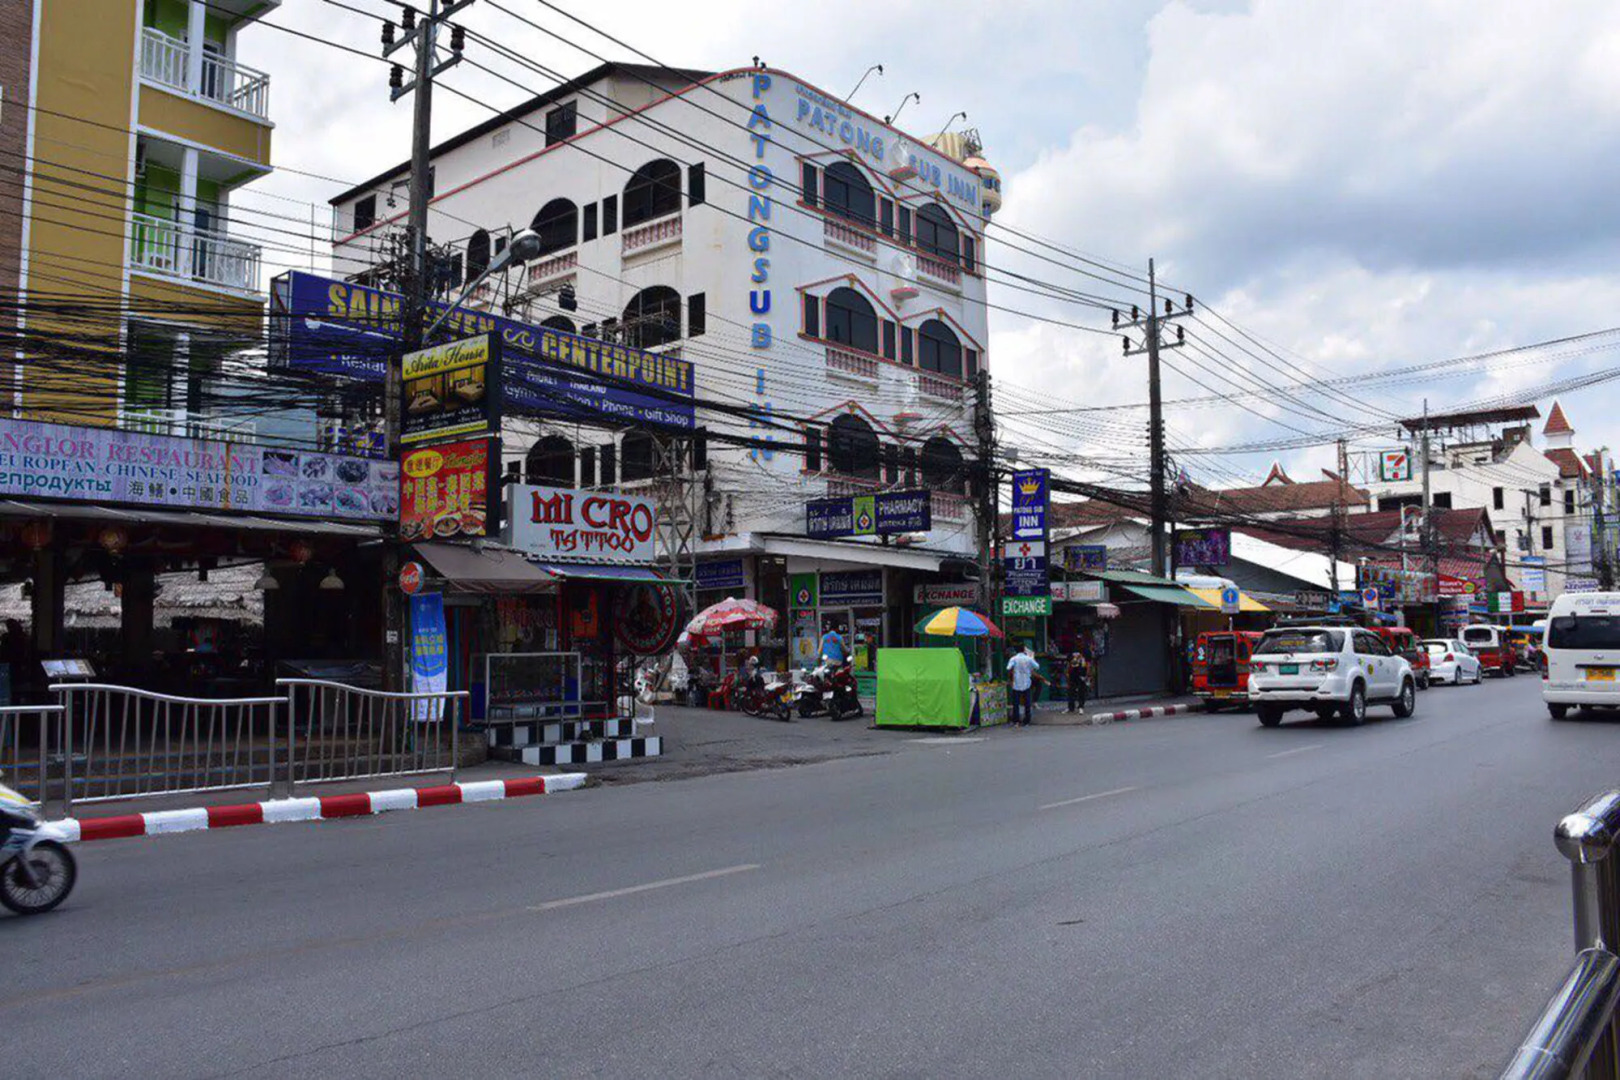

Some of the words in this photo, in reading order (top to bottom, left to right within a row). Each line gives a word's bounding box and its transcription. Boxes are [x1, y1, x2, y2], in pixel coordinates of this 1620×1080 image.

[796, 97, 885, 160] PATONG
[907, 153, 942, 187] SUB
[947, 173, 977, 206] INN
[443, 342, 486, 366] House
[540, 331, 690, 390] CENTERPOINT
[0, 432, 95, 459] NGLOR
[106, 442, 260, 475] RESTAURANT
[878, 499, 923, 515] PHARMACY
[1019, 515, 1039, 528] INN
[550, 529, 635, 553] TATTOO
[917, 588, 976, 602] EXCHANGE
[1002, 597, 1047, 614] EXCHANGE
